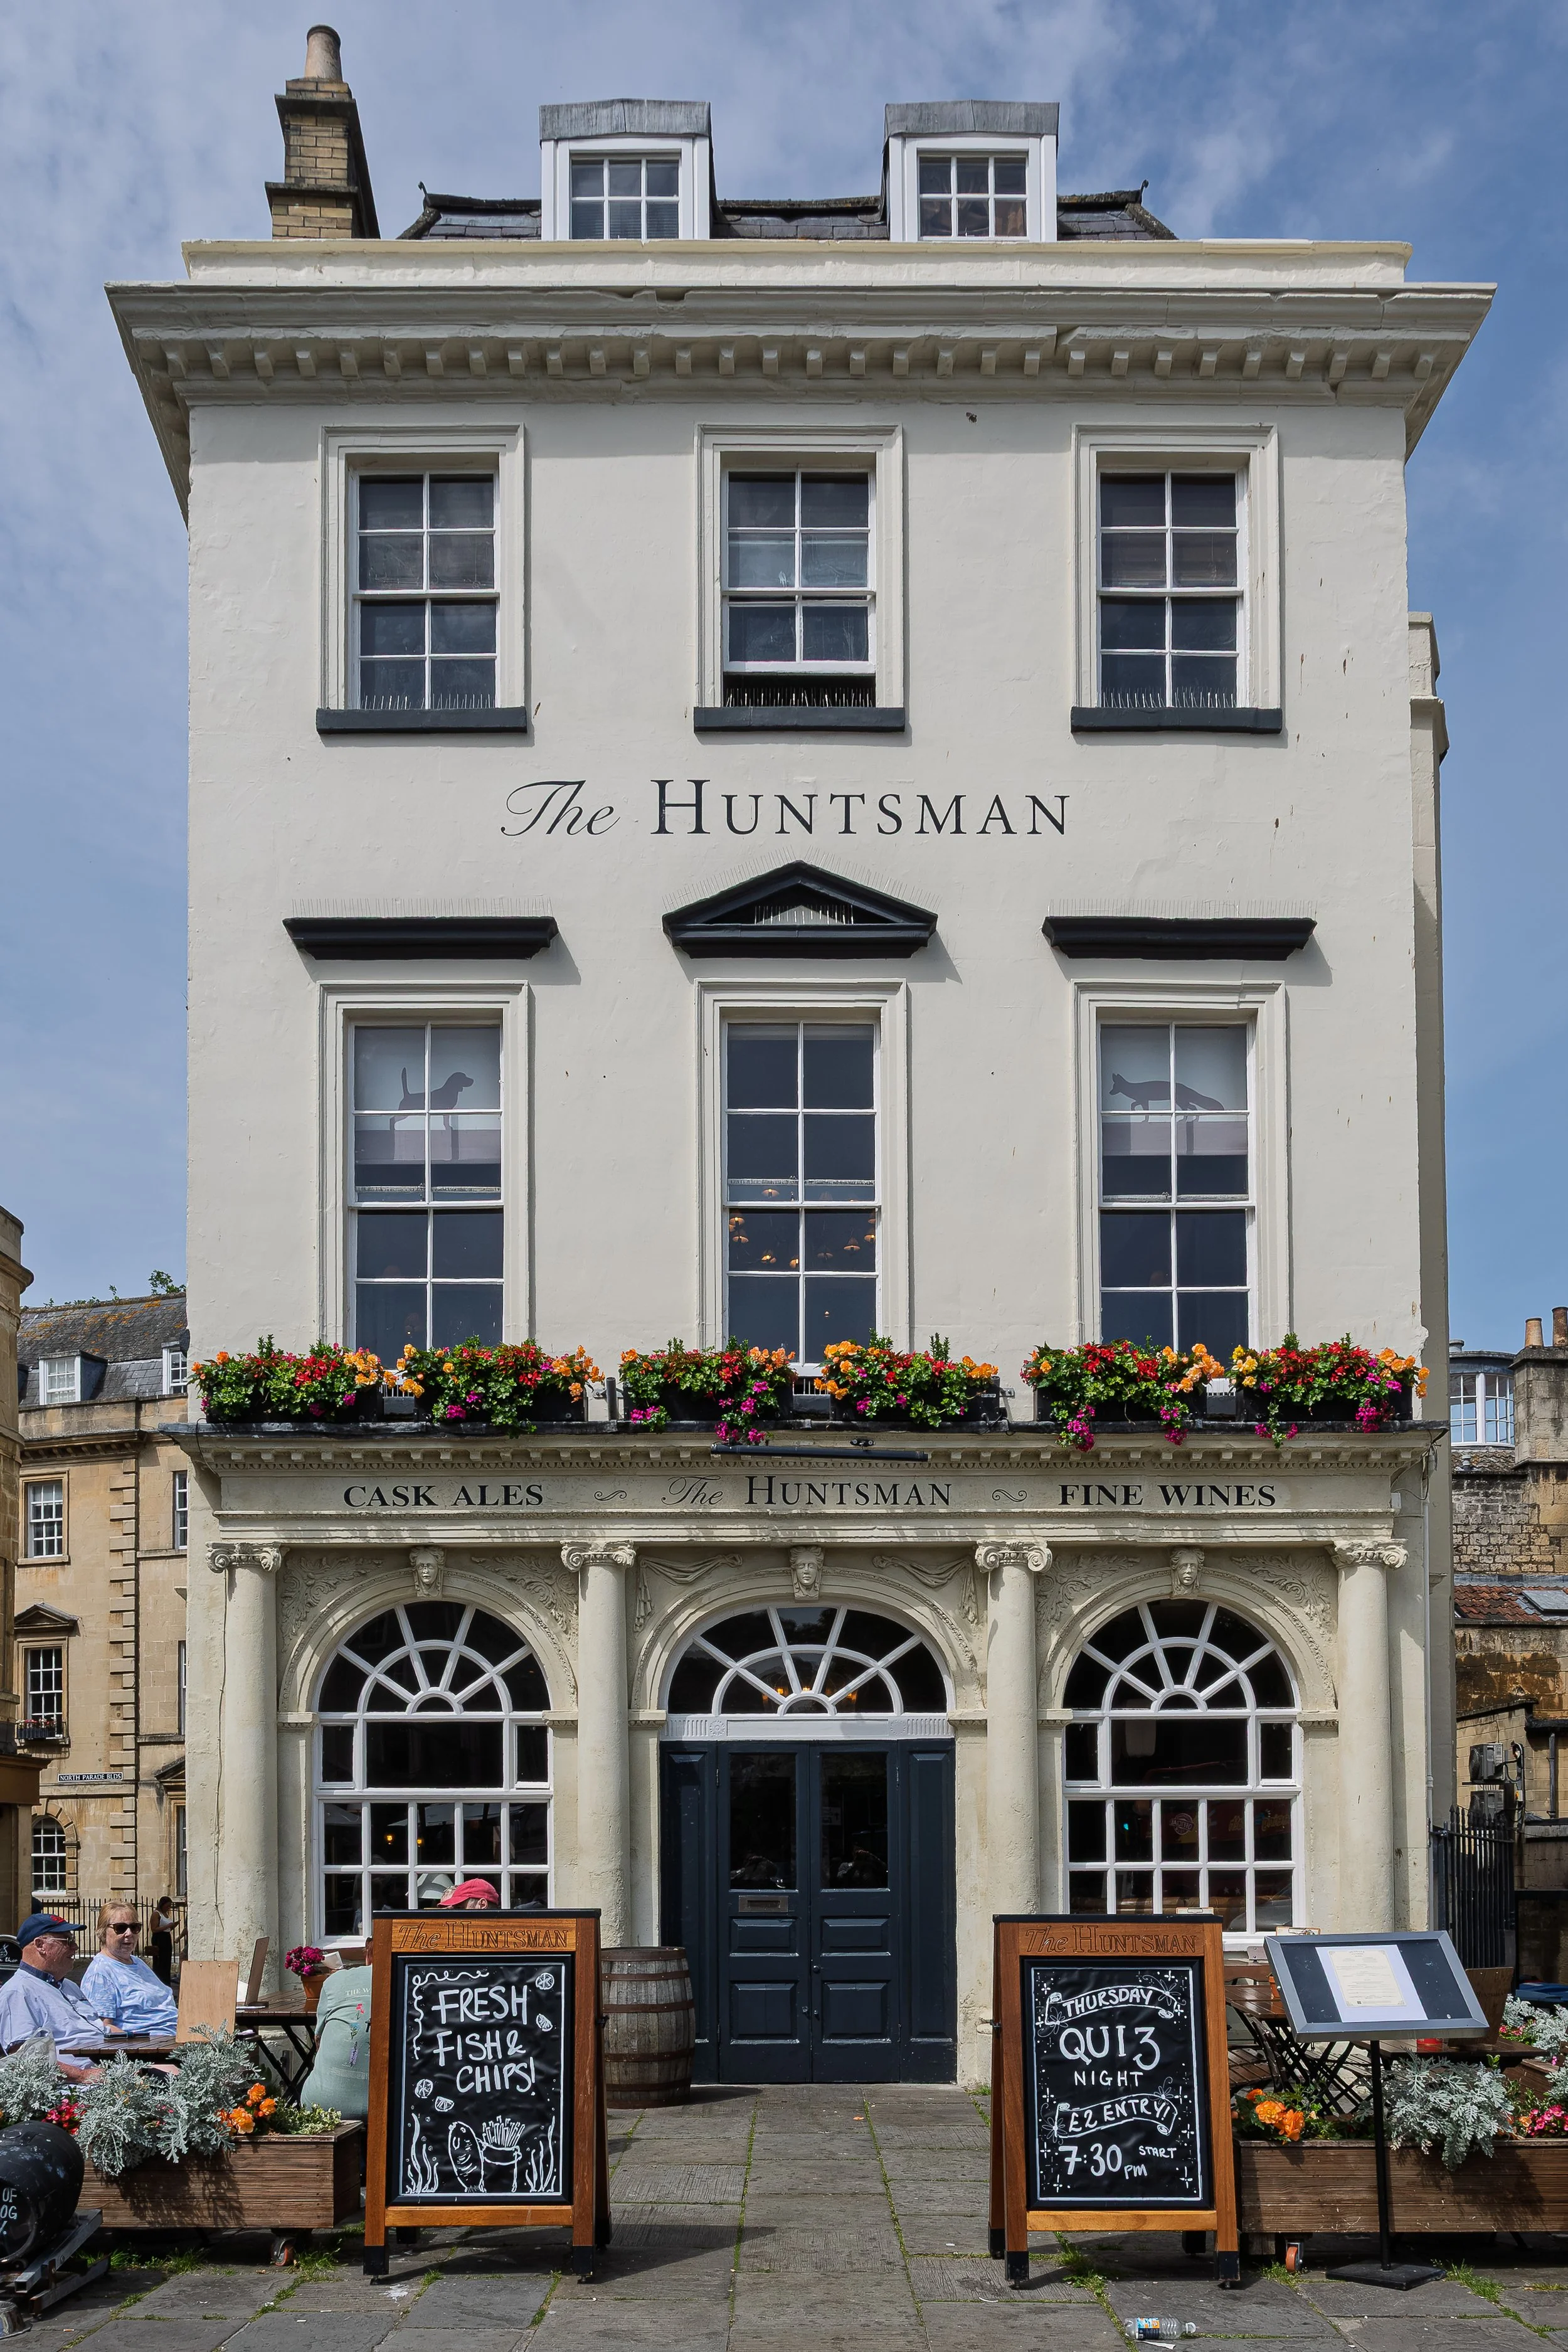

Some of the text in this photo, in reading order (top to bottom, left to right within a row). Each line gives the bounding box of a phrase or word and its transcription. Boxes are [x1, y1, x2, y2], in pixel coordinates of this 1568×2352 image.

[501, 778, 1071, 836] The HUNTSMAN
[343, 1484, 544, 1507] CASK ALES
[661, 1475, 952, 1506] The HUNTSMAN
[1058, 1484, 1276, 1507] FINE WINES
[399, 1920, 569, 1949] The HUNTSMAN
[1025, 1925, 1197, 1953] The HUNTSMAN
[346, 1988, 361, 1996] THE
[432, 1984, 528, 2025] FRESH
[1062, 1988, 1153, 2018] THURSDAY
[433, 2030, 502, 2066] FISH
[456, 2057, 536, 2096] CHIPS!
[1074, 2070, 1143, 2087] NIGHT
[1068, 2099, 1170, 2133] £2 ENTRY!
[1058, 2143, 1123, 2177] 7:30
[1138, 2145, 1177, 2159] START
[3, 2188, 18, 2202] OF
